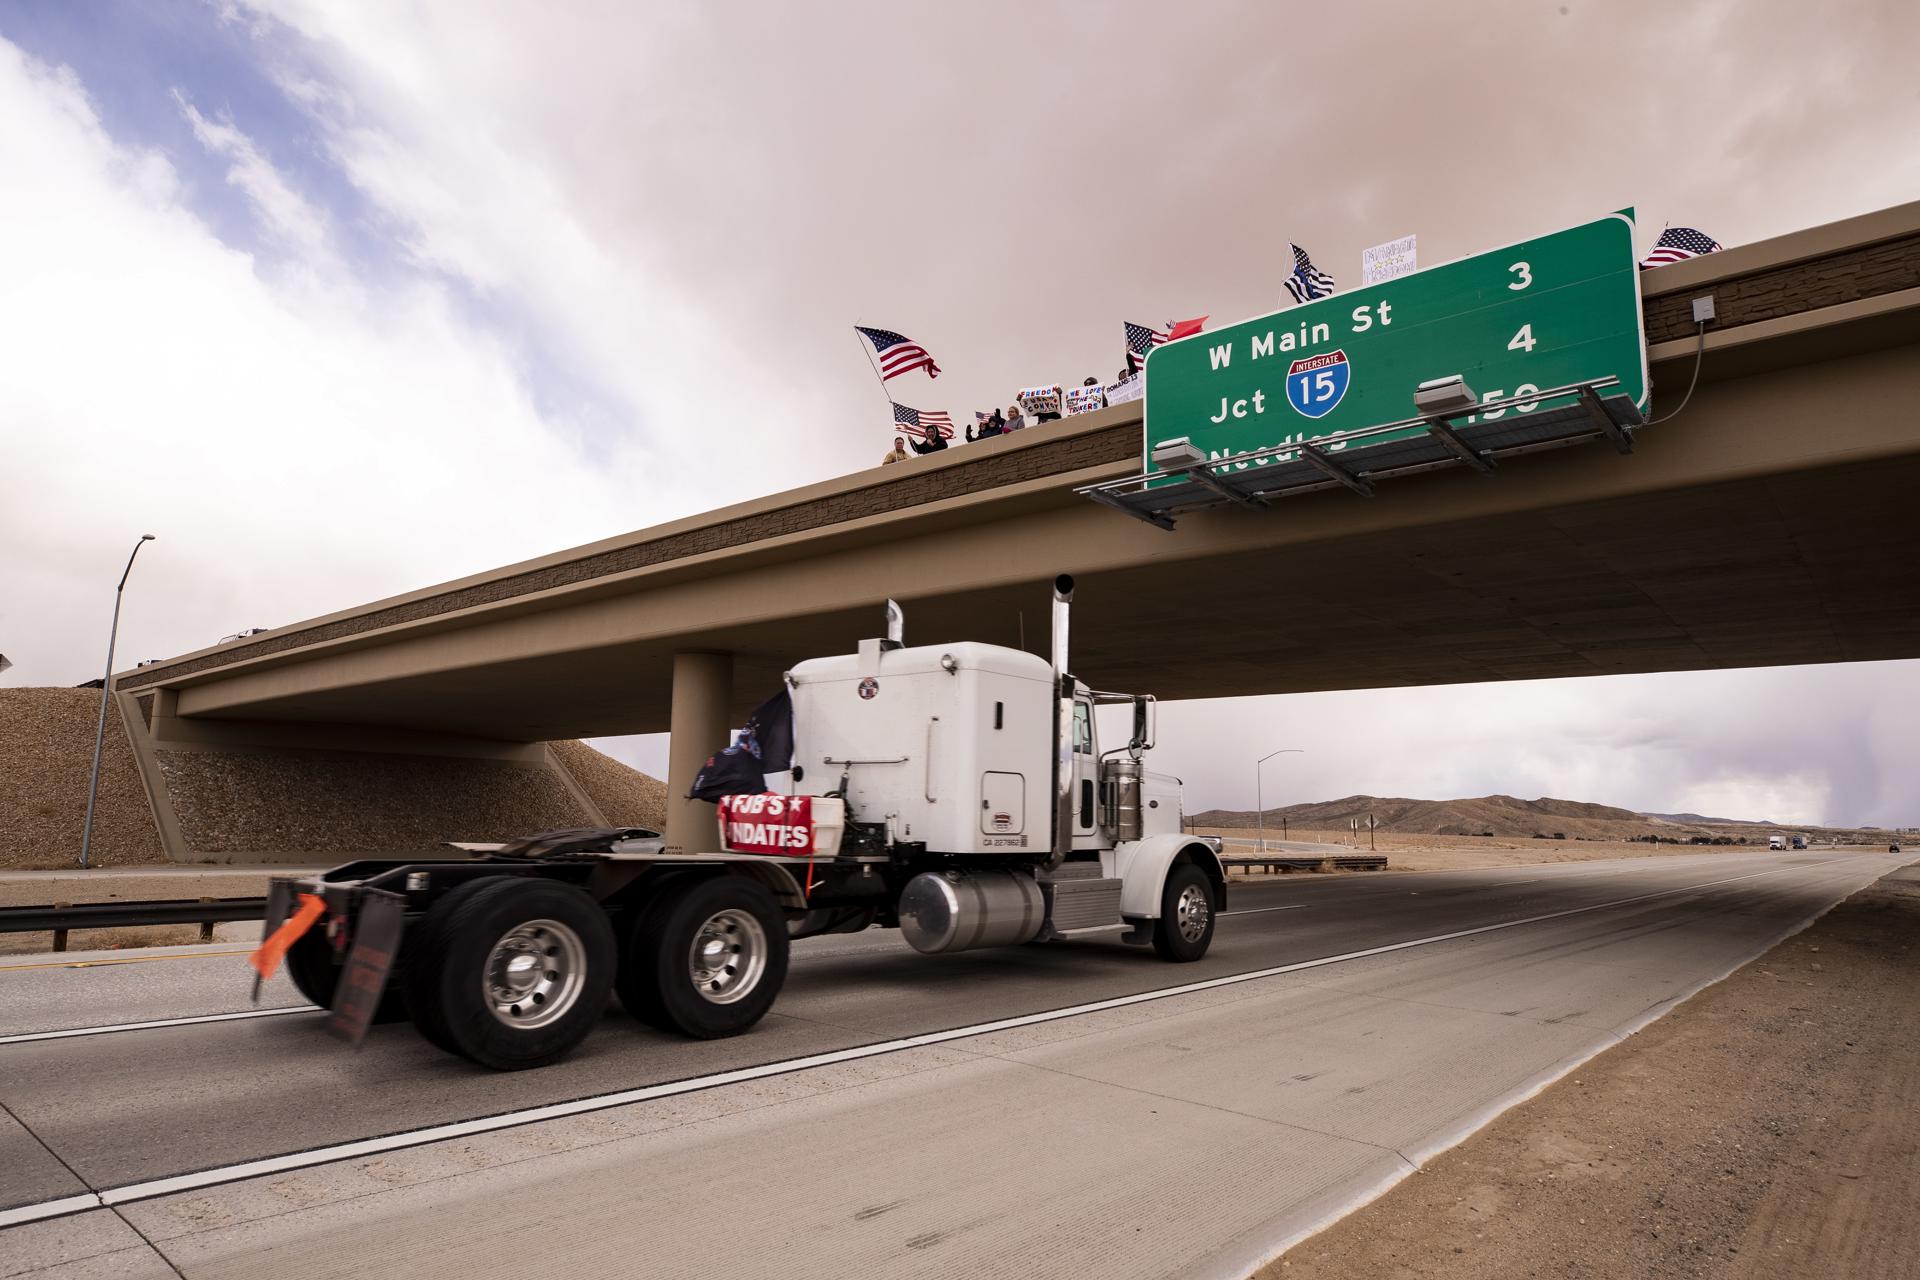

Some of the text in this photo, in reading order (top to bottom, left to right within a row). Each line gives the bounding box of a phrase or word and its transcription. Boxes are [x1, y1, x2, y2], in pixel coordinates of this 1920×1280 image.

[1209, 261, 1533, 371] W Main St 3
[1210, 323, 1537, 423] Jct 15 4
[1296, 355, 1339, 372] INTERSTATE
[1085, 387, 1101, 395] LOVE
[1467, 383, 1539, 424] 50
[731, 795, 785, 815] FJB'S
[729, 822, 809, 848] NDATES
